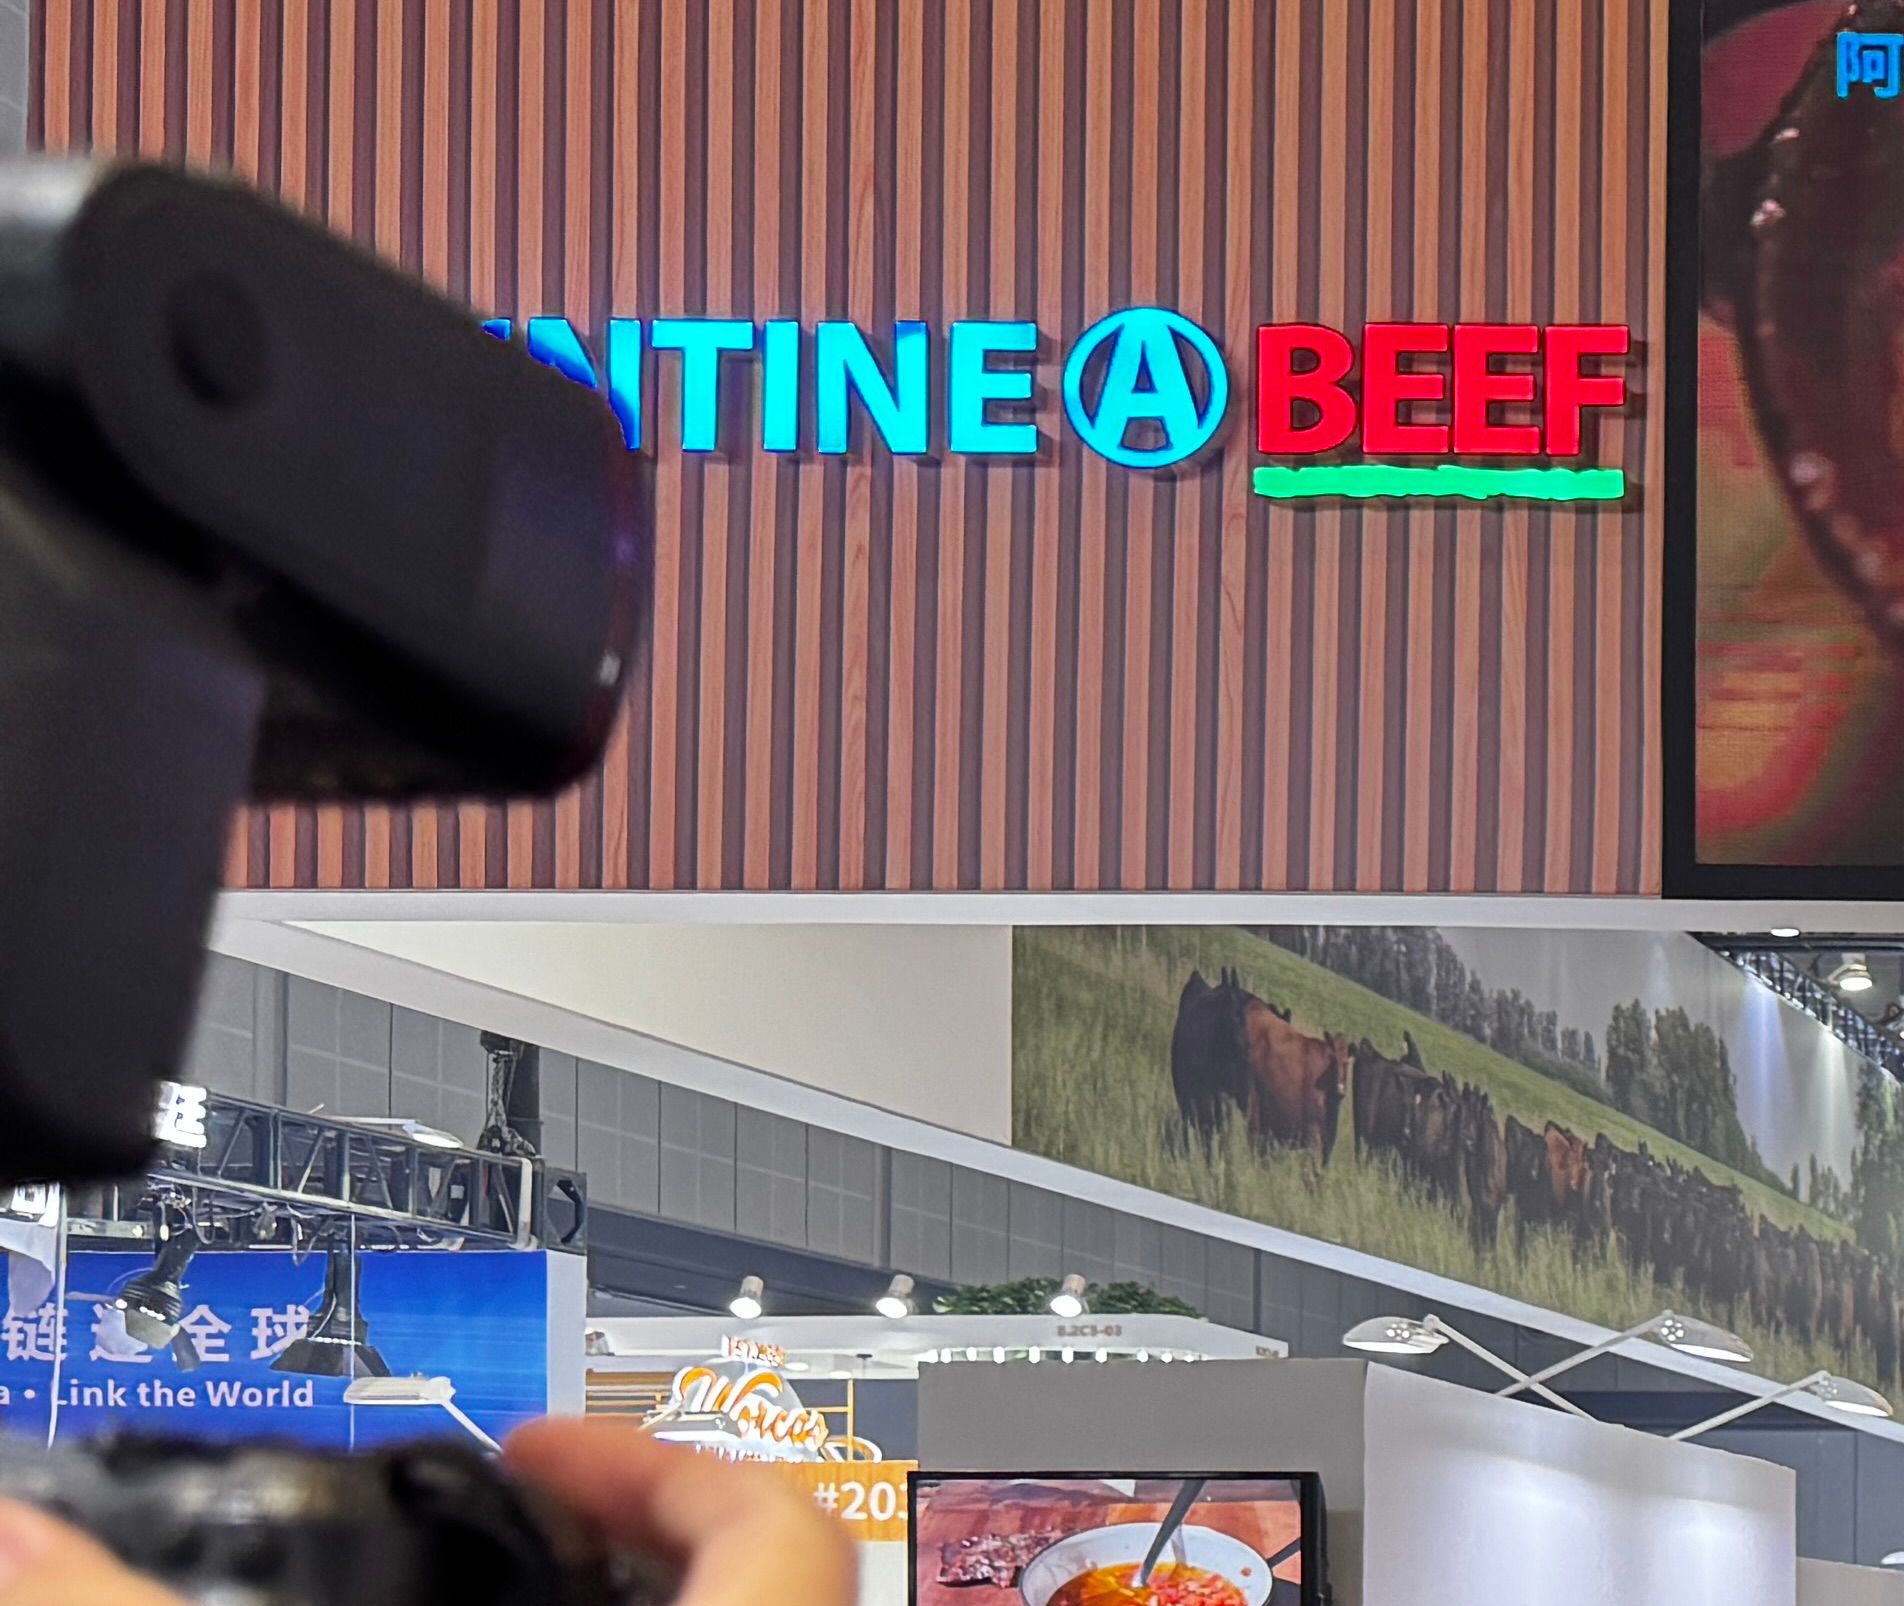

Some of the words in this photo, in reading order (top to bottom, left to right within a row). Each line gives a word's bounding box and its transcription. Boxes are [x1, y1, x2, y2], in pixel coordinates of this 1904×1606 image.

[482, 316, 1037, 454] NTINE
[1255, 322, 1631, 459] BEEF
[57, 1379, 127, 1408] ink
[137, 1380, 196, 1408] the
[206, 1380, 314, 1408] World
